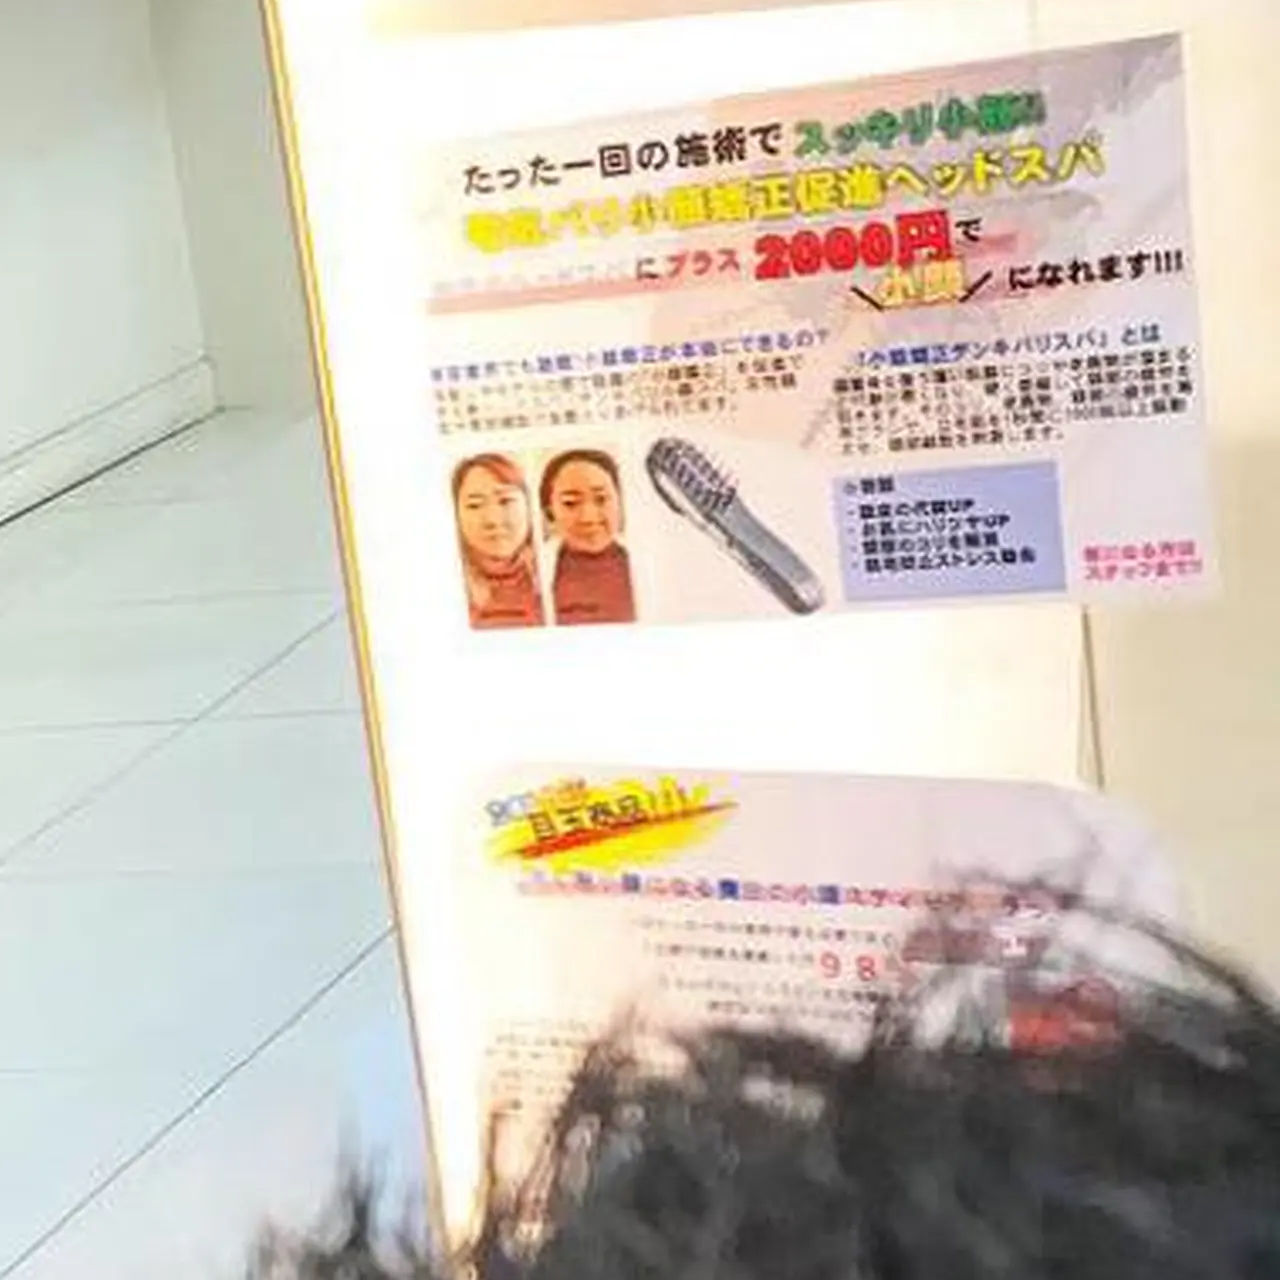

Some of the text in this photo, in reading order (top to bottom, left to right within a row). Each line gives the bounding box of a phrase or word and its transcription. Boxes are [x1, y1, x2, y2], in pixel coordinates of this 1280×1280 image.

[463, 122, 784, 196] たった一回の施術で
